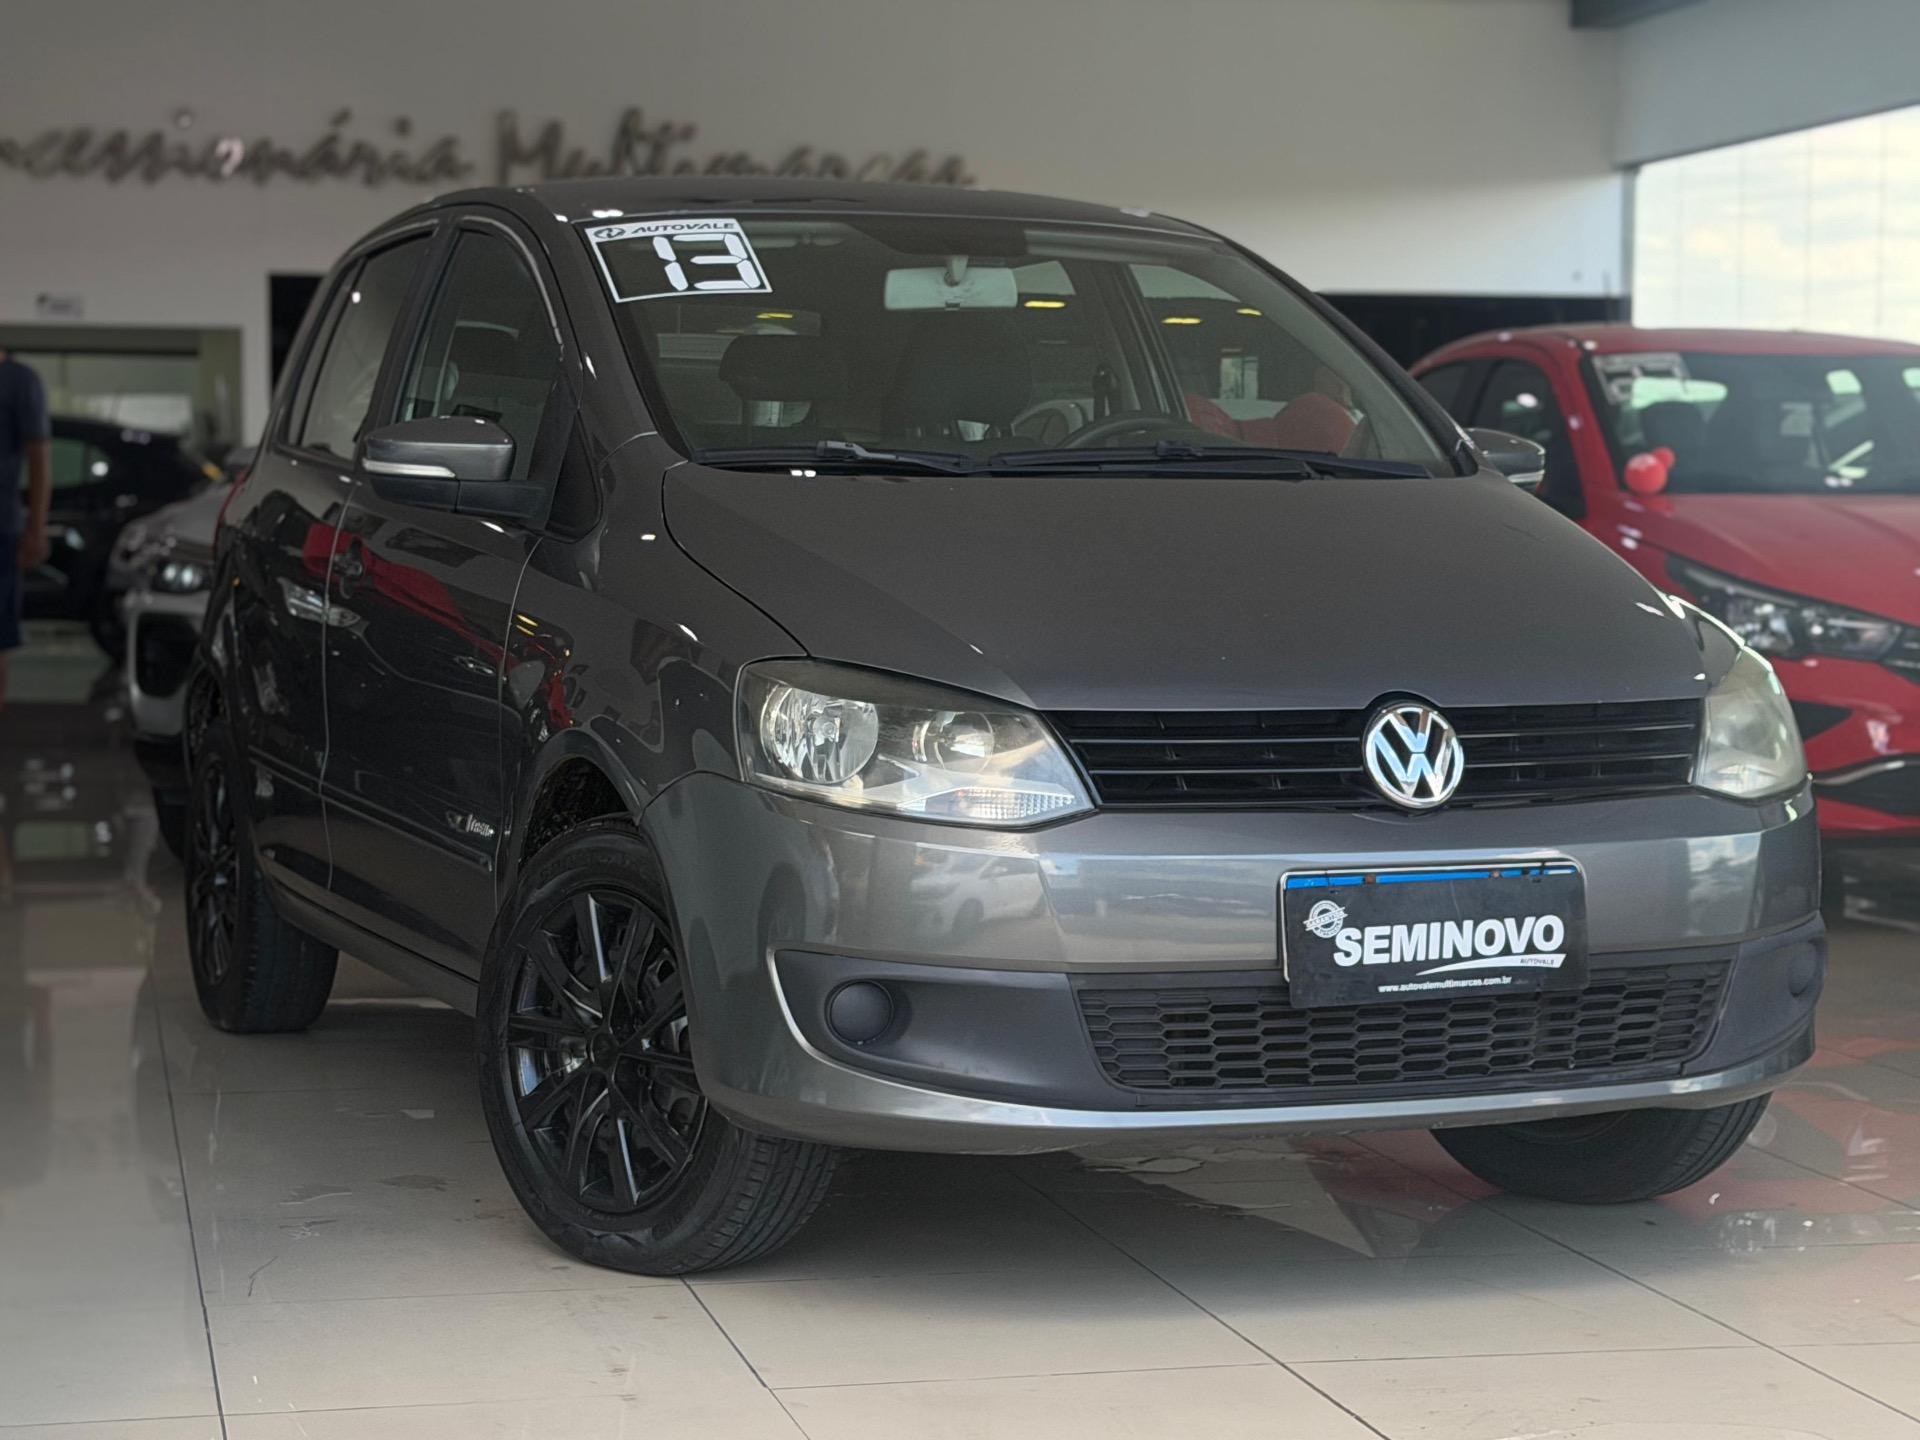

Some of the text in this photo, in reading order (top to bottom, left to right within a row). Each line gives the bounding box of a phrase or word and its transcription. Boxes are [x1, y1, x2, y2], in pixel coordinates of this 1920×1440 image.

[631, 222, 736, 235] AUTOVALE
[652, 233, 761, 291] 13
[1333, 914, 1565, 967] SEMINOVO
[1378, 975, 1513, 993] www.autovalemultimarcas.com.br
